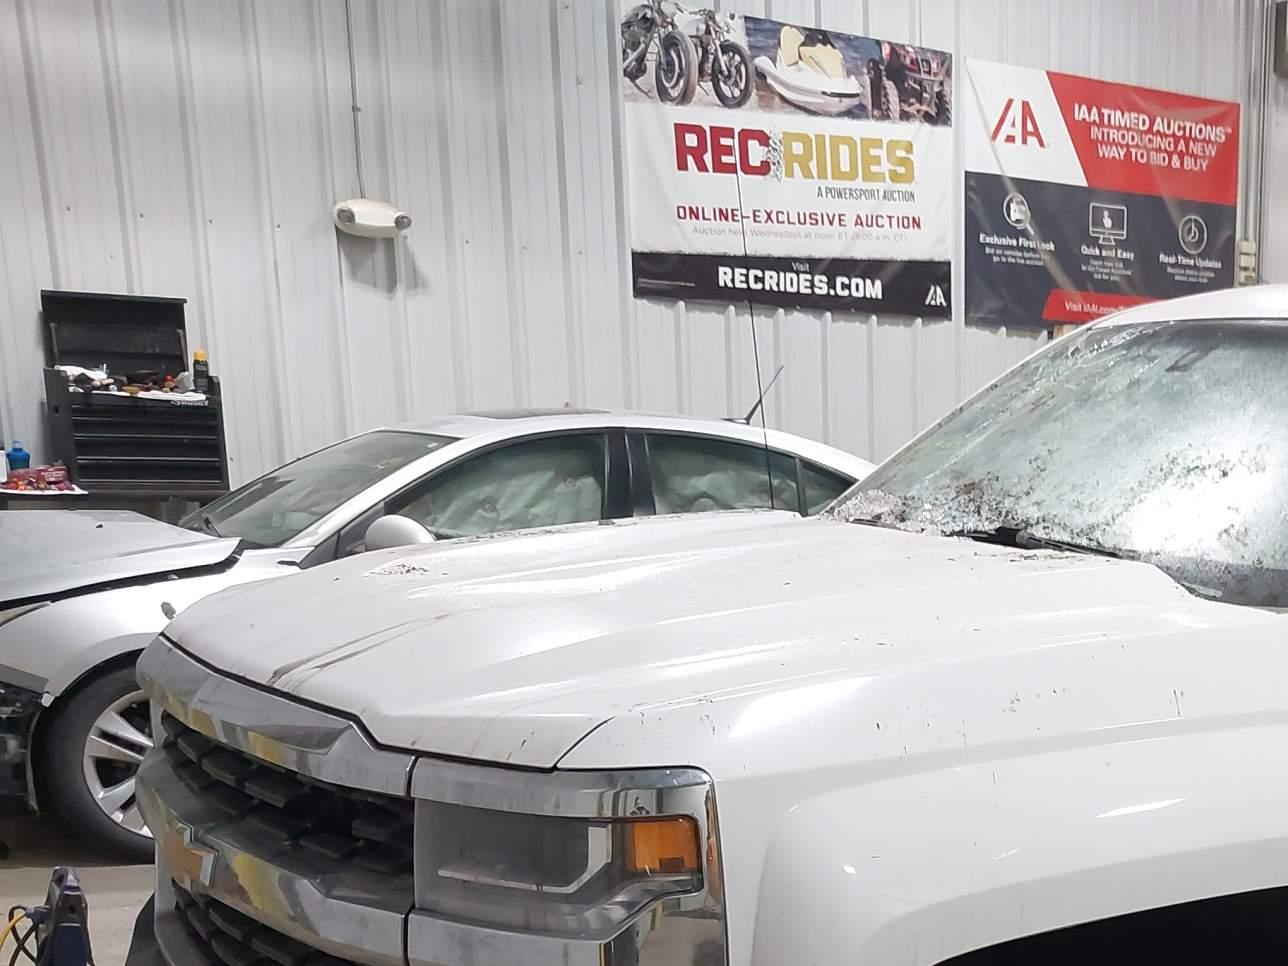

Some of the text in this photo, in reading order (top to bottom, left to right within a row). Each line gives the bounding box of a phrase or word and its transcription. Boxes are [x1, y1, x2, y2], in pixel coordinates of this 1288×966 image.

[1074, 103, 1099, 122] IAA
[1101, 108, 1150, 130] TIMED
[673, 122, 917, 184] REC RIDES
[1091, 126, 1217, 157] INTRODUCING A NEW
[1097, 143, 1210, 172] WAY TO BID & BUY
[817, 187, 915, 202] A POWERSPORT AUCTION
[676, 205, 922, 230] ONLINE-EXCLUSIVE AUCTION
[979, 232, 1018, 248] Exclusive
[1117, 249, 1134, 262] Easy
[718, 266, 883, 300] RECRIDES.COM
[1065, 301, 1082, 312] Visit
